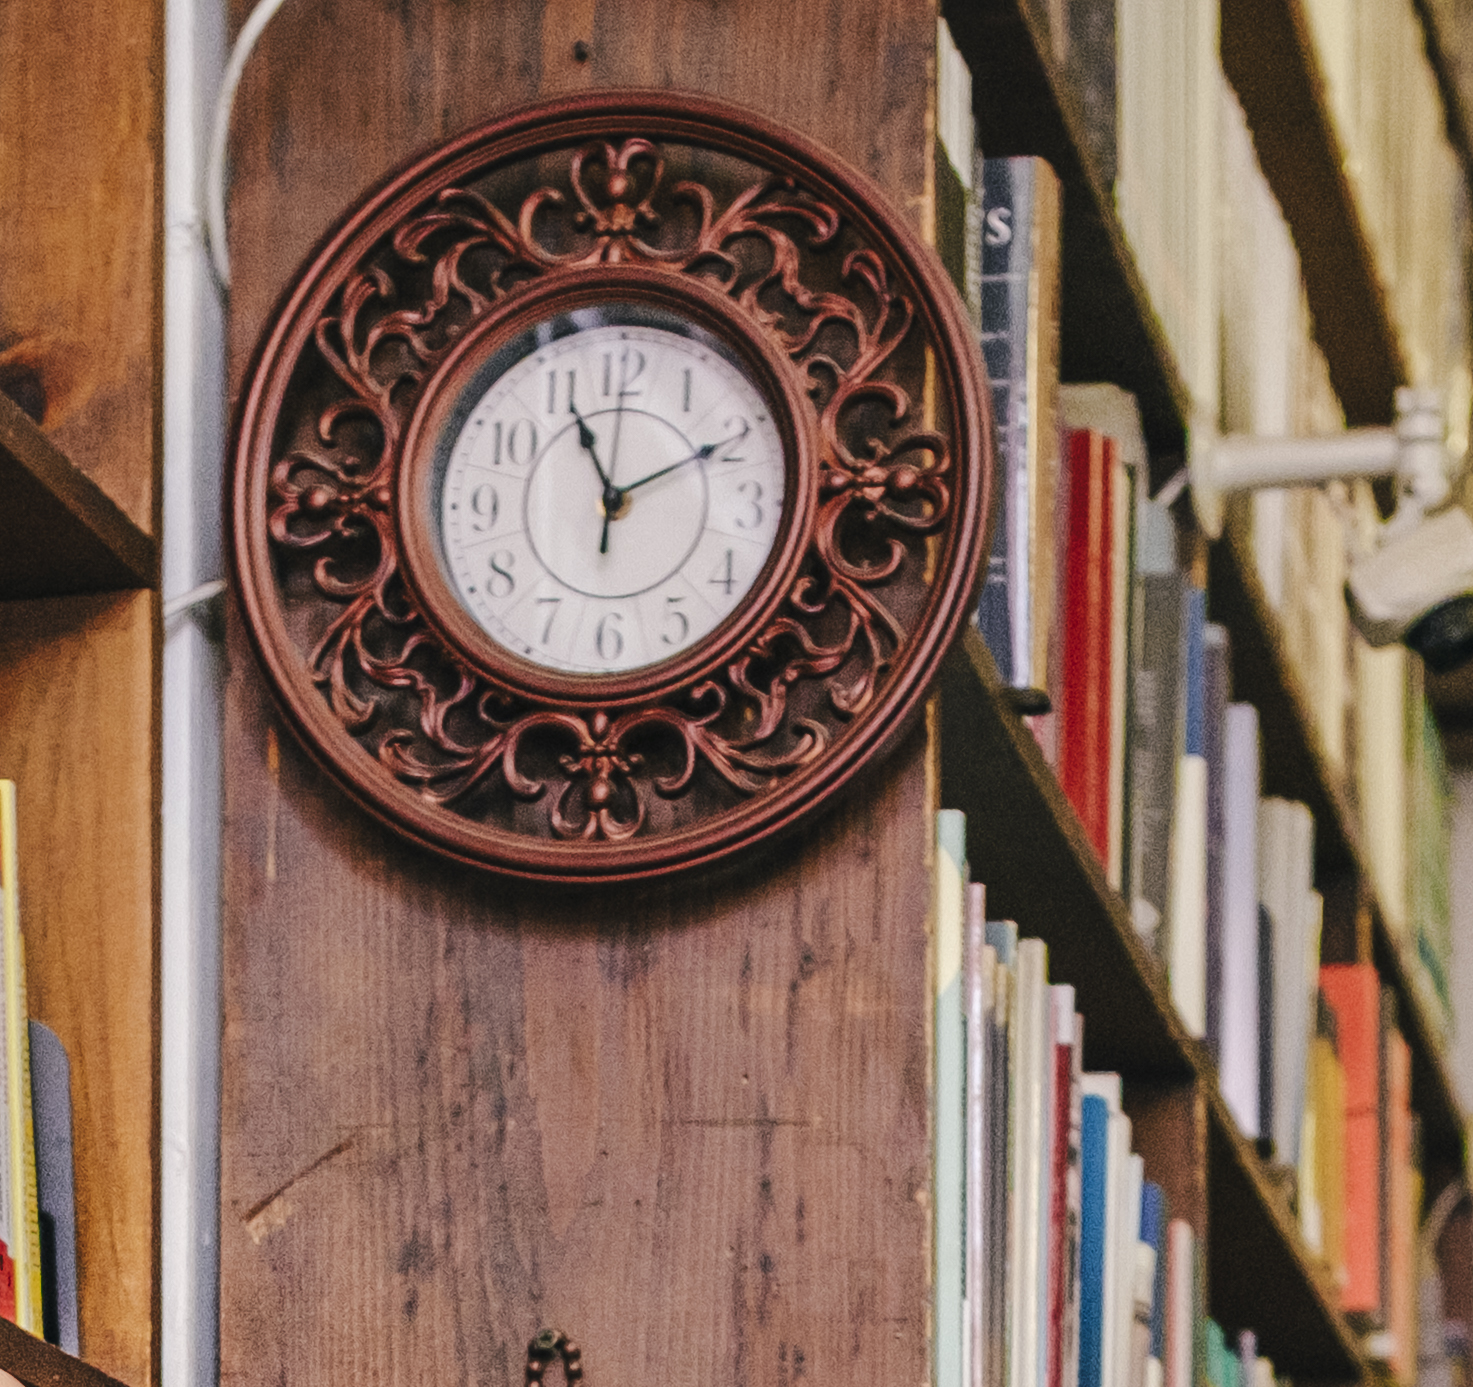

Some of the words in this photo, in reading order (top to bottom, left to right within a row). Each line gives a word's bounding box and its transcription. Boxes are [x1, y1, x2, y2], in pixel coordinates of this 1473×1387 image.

[546, 370, 575, 413] 11
[603, 348, 646, 396] 12
[683, 368, 691, 411] 1
[495, 418, 538, 465] 10
[722, 416, 749, 462] 2
[472, 484, 497, 530] 9
[736, 480, 763, 529] 3
[487, 550, 514, 597] 8
[709, 550, 737, 595] 4
[537, 598, 561, 644] 7
[595, 612, 624, 659] 6
[662, 597, 688, 644] 5
